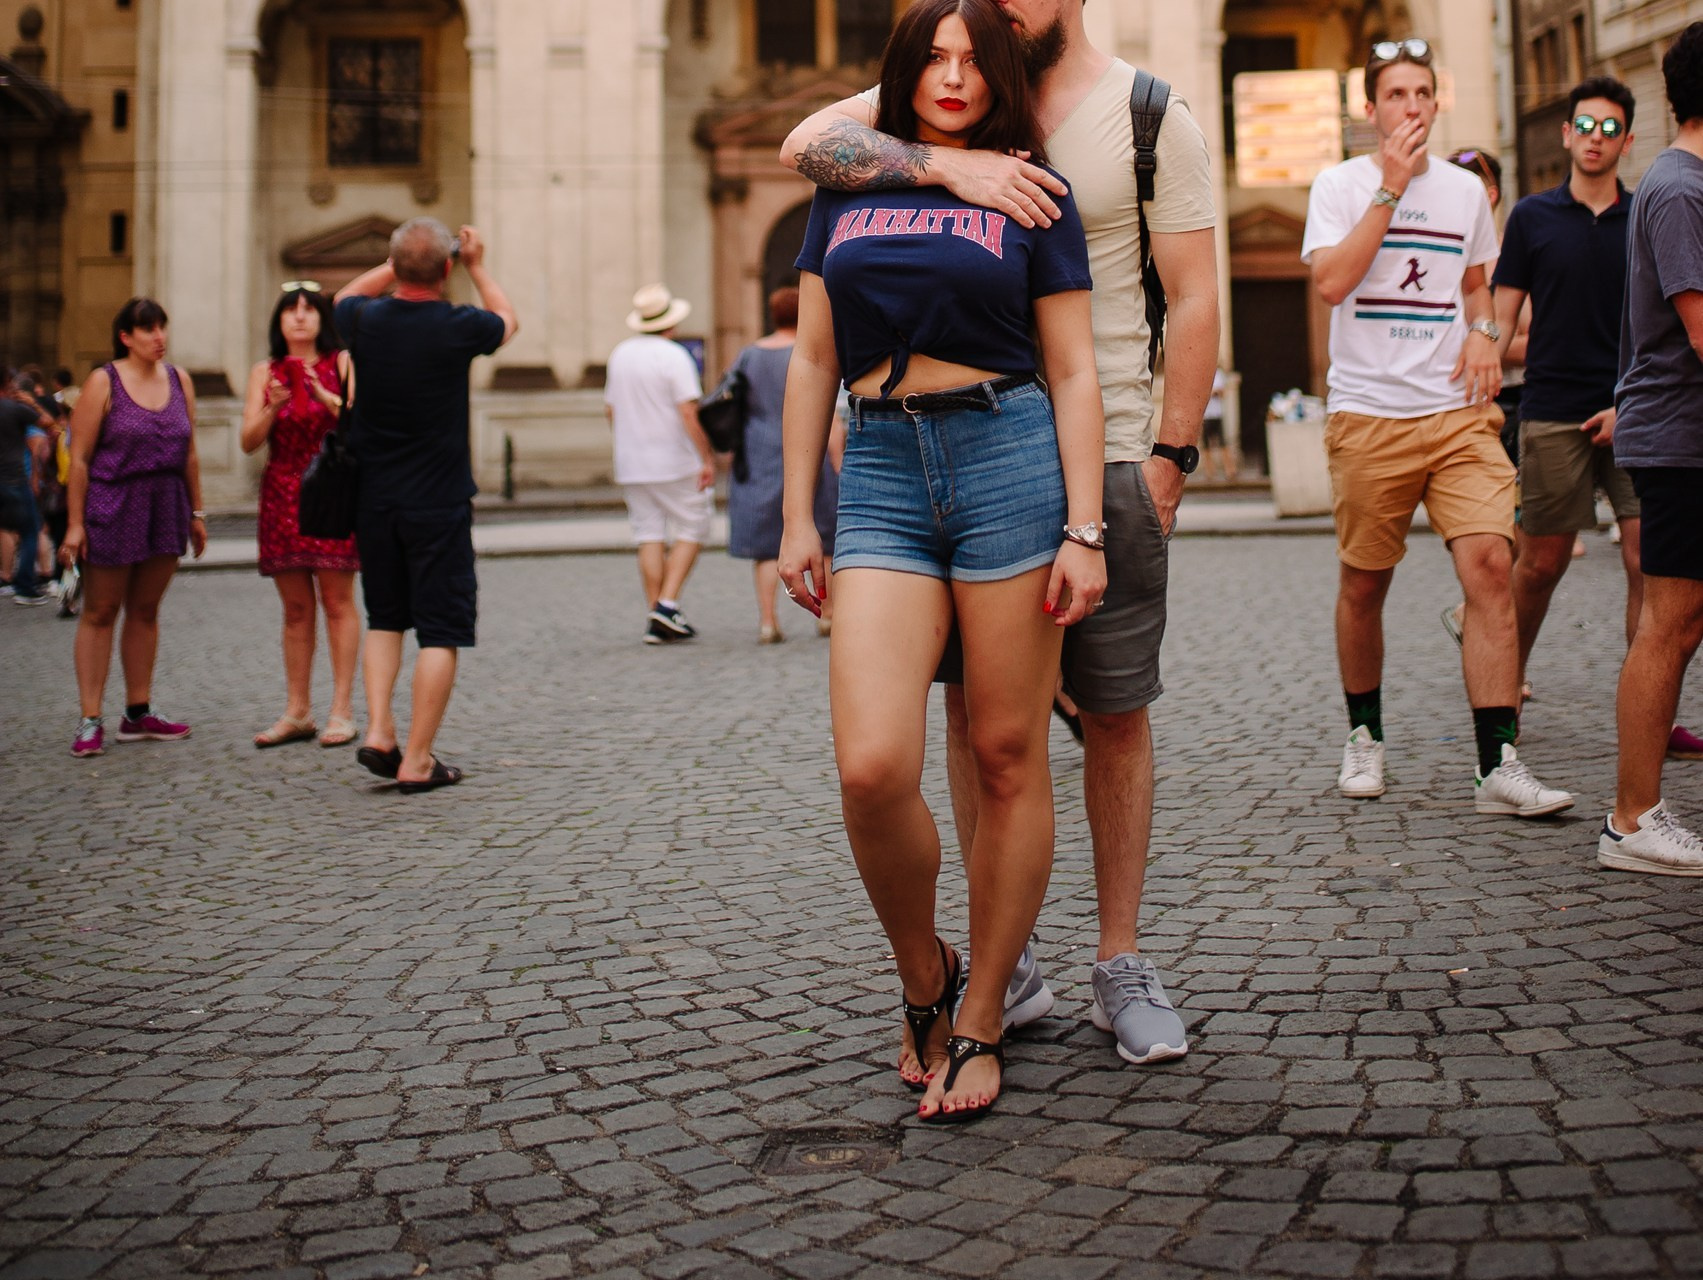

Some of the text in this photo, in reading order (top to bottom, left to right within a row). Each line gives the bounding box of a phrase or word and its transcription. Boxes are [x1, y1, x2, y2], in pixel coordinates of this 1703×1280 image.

[1398, 208, 1429, 223] 1996
[825, 208, 1006, 260] MANHATTAN
[1389, 326, 1435, 341] BERLIN
